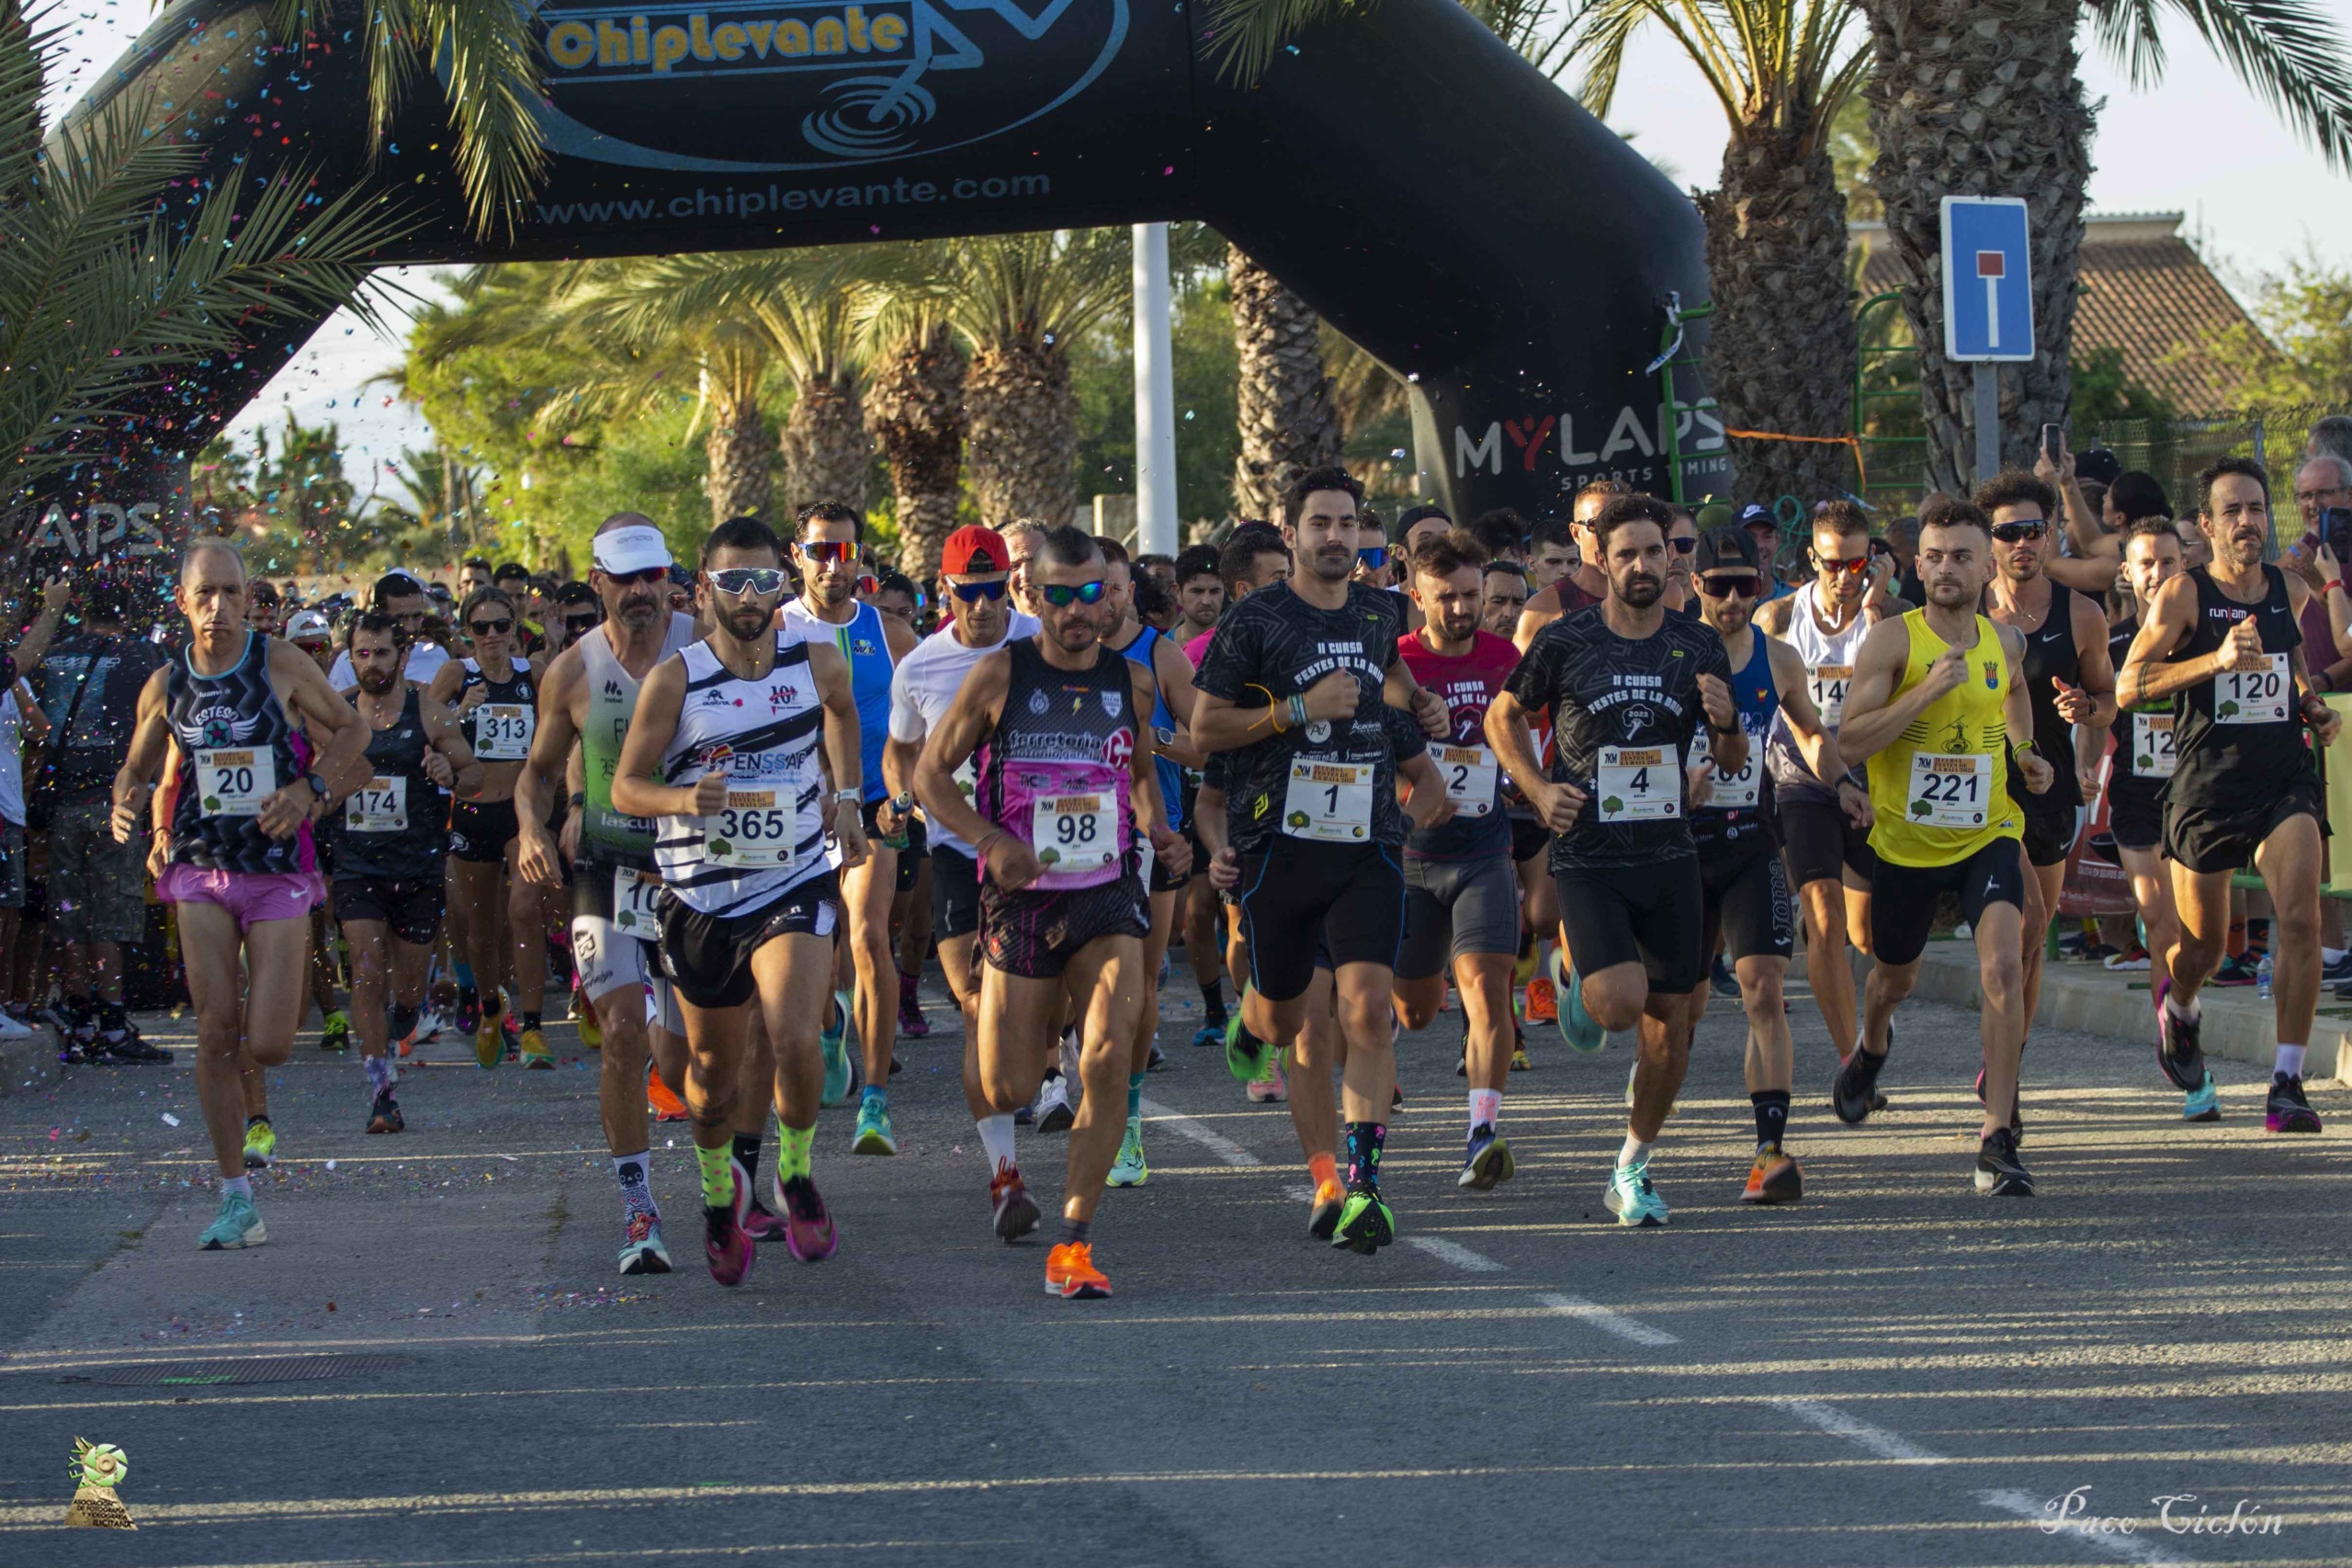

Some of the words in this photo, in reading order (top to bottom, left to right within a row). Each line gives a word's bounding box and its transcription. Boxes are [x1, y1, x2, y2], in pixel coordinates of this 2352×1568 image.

[547, 6, 909, 74] Chiplevante
[540, 173, 1051, 225] www.chiplevante.com
[1455, 398, 1726, 478] MYLAPS
[1317, 642, 1326, 654] II
[1329, 642, 1363, 654] CURSA
[1294, 659, 1335, 686] FESTES
[1338, 656, 1351, 668] DE
[1353, 659, 1367, 671] LA
[1613, 675, 1623, 686] II
[1625, 675, 1662, 687] CURSA
[1453, 681, 1485, 694] CURSA
[1813, 680, 1850, 703] 14
[2229, 672, 2280, 699] 120
[1461, 693, 1474, 704] DE
[1476, 694, 1487, 705] LA
[1588, 690, 1628, 715] FESTES
[1632, 689, 1647, 700] DE
[1649, 691, 1663, 703] LA
[196, 706, 240, 725] ESTESO
[485, 718, 526, 739] 313
[1430, 748, 1443, 759] 7KM
[1694, 740, 1706, 752] 7KM
[735, 753, 805, 771] ENSSAP
[1605, 753, 1617, 764] 7KM
[1918, 758, 1931, 769] 7KM
[217, 766, 254, 795] 20
[1450, 764, 1468, 791] 2
[1630, 767, 1649, 793] 4
[1921, 773, 1977, 802] 221
[355, 792, 397, 813] 174
[1041, 800, 1054, 811] 7KM
[1325, 784, 1339, 813] 1
[718, 809, 784, 840] 365
[1057, 814, 1096, 844] 98
[622, 868, 636, 878] 7KM
[1770, 858, 1792, 933] Joma
